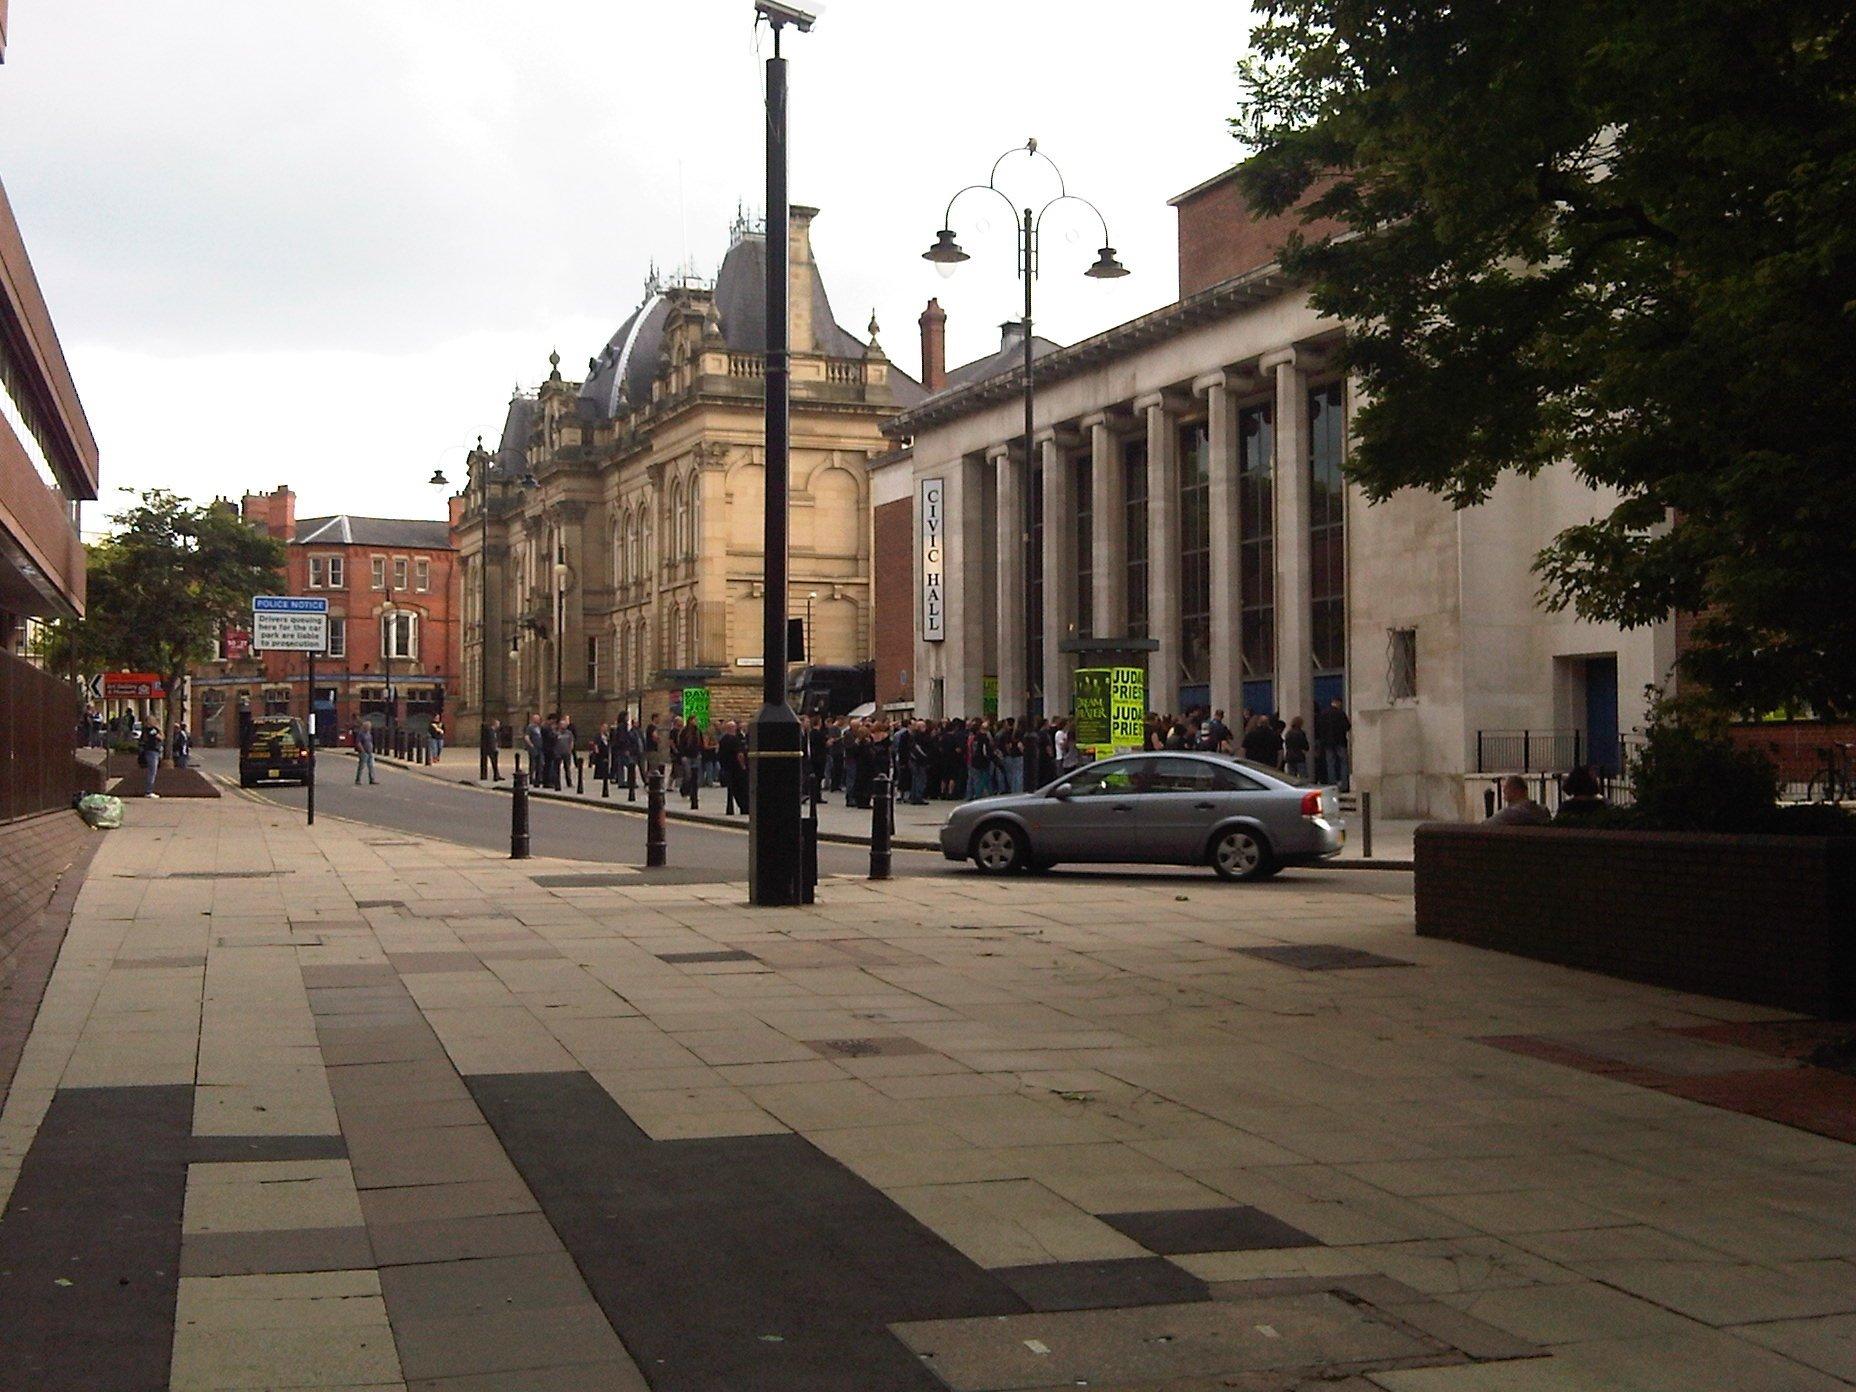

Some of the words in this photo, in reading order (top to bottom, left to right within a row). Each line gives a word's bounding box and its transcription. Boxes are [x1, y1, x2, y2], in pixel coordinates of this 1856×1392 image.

[927, 489, 939, 563] CIVIC
[257, 600, 288, 608] POLICE
[291, 601, 324, 609] NOTICE
[927, 573, 940, 631] HALL
